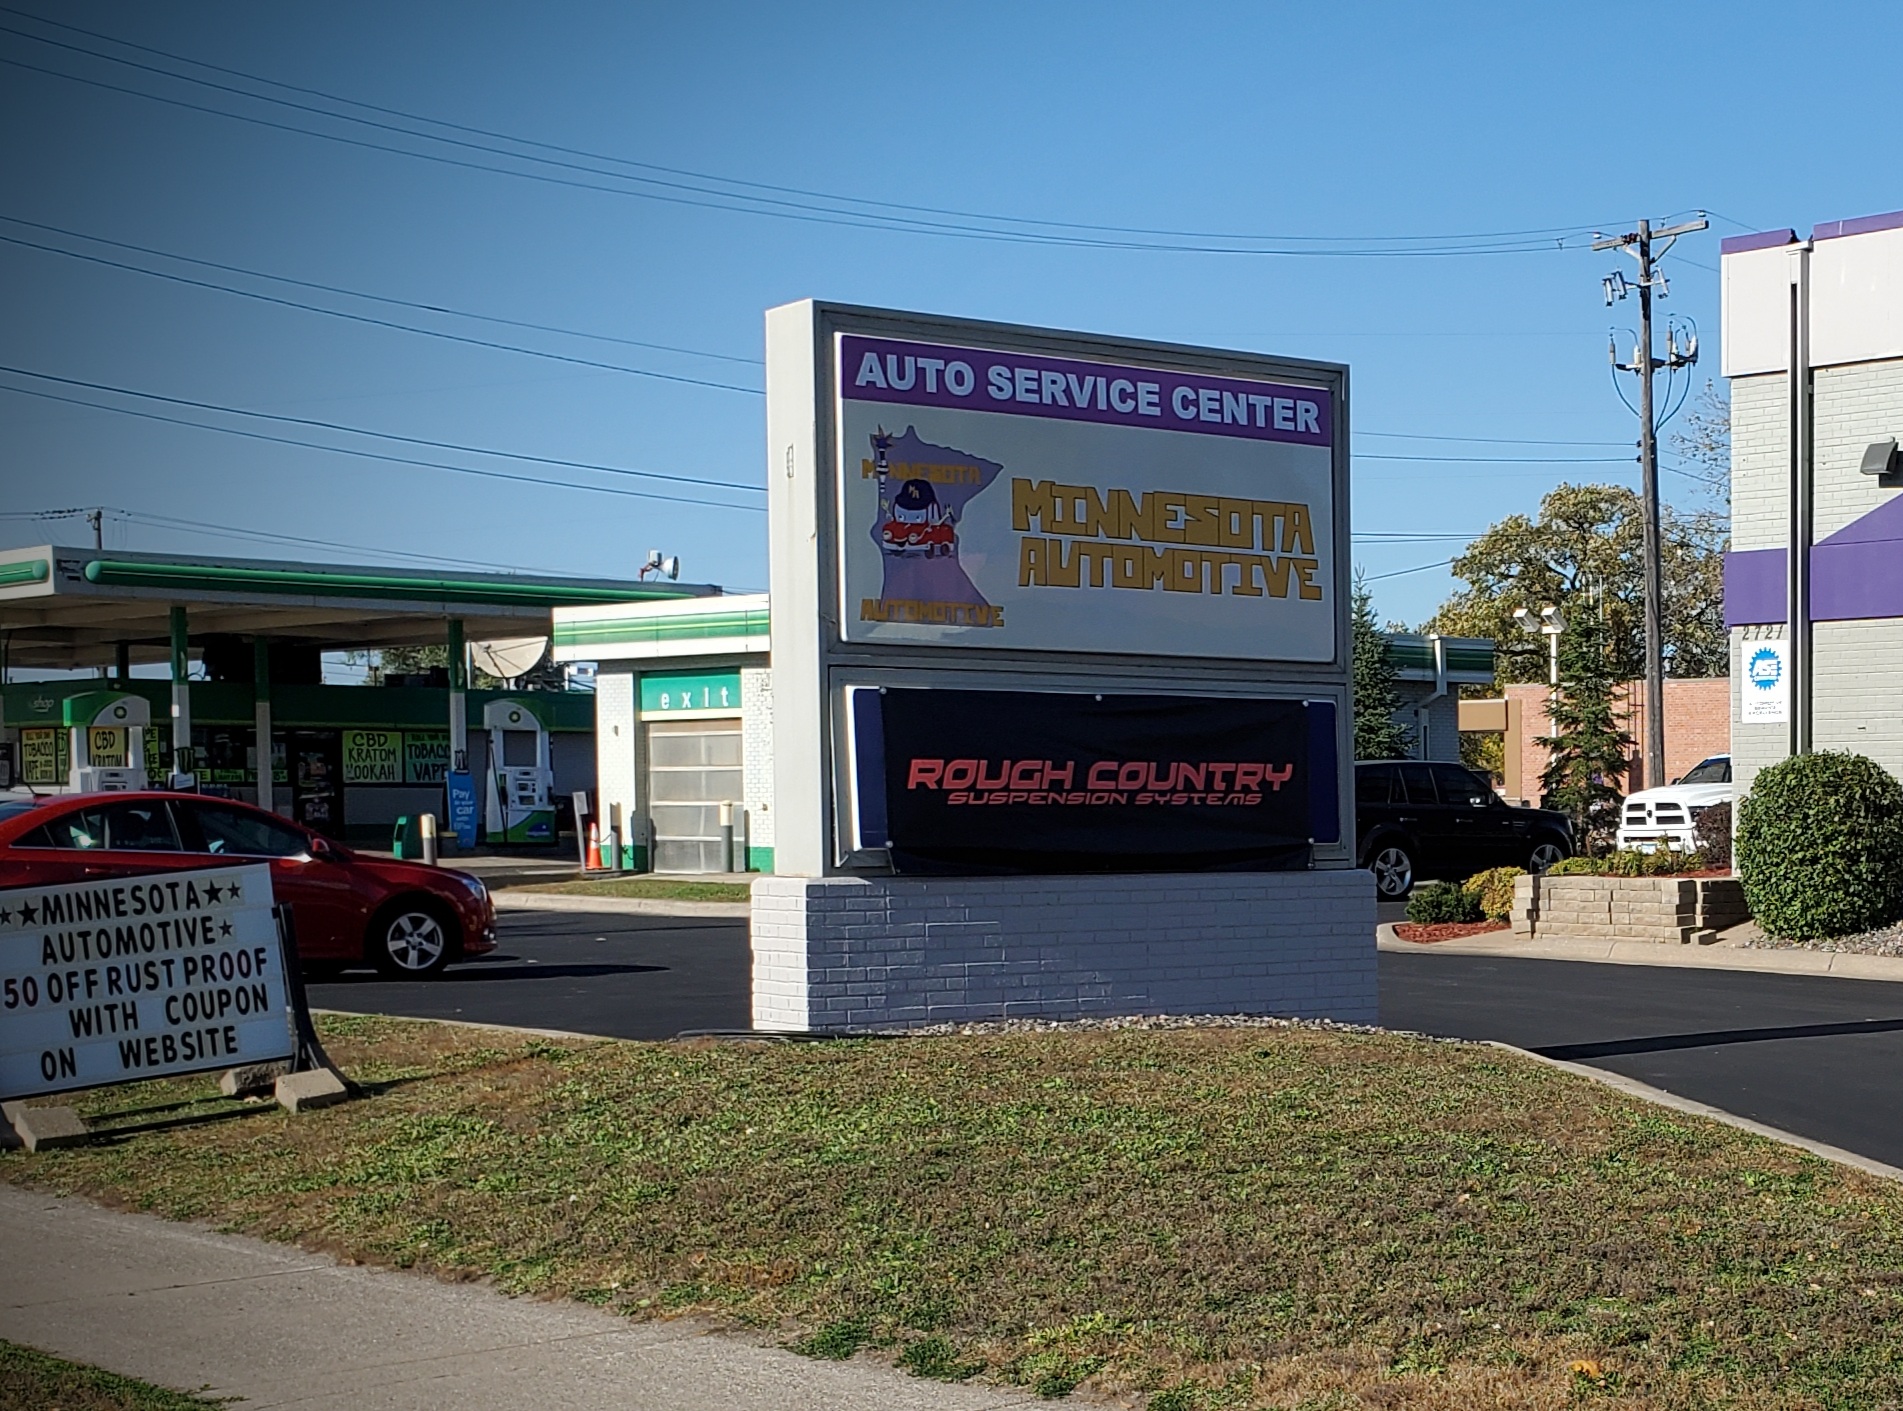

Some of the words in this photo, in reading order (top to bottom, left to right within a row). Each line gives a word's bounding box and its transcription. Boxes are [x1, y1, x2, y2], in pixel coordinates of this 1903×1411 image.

[855, 352, 975, 397] AUTO
[988, 365, 1160, 416] SERVICE
[1172, 387, 1321, 434] CENTER
[862, 459, 981, 485] MNNESOTA
[1012, 477, 1315, 556] MINNESOTA
[1018, 537, 1323, 601] AUTOMOTIVE
[860, 598, 1004, 627] AUTOMOTIVE
[1742, 624, 1783, 640] 2721
[33, 696, 54, 709] shop
[661, 686, 729, 709] exit
[24, 742, 53, 758] TOBACCO
[94, 731, 115, 750] CBD
[352, 733, 388, 748] CBD
[407, 743, 450, 759] TOBACC
[348, 747, 397, 763] KRATOM
[907, 758, 1075, 791] ROUGH
[1087, 761, 1294, 792] COUNTRY
[452, 788, 470, 800] Pay
[947, 791, 1127, 806] SUSPENSION
[1135, 793, 1263, 806] SYSTEMS
[456, 805, 474, 815] car
[42, 880, 200, 925] MINNESOTA
[42, 916, 215, 965] AUTOMOTIVE
[4, 976, 38, 1009] 50
[47, 969, 98, 1004] OFF
[106, 959, 175, 996] RUST
[182, 947, 267, 985] PROOF
[69, 1001, 138, 1038] WITH
[165, 983, 268, 1025] COUPON
[41, 1047, 77, 1081] ON
[119, 1025, 238, 1069] WEBSITE
